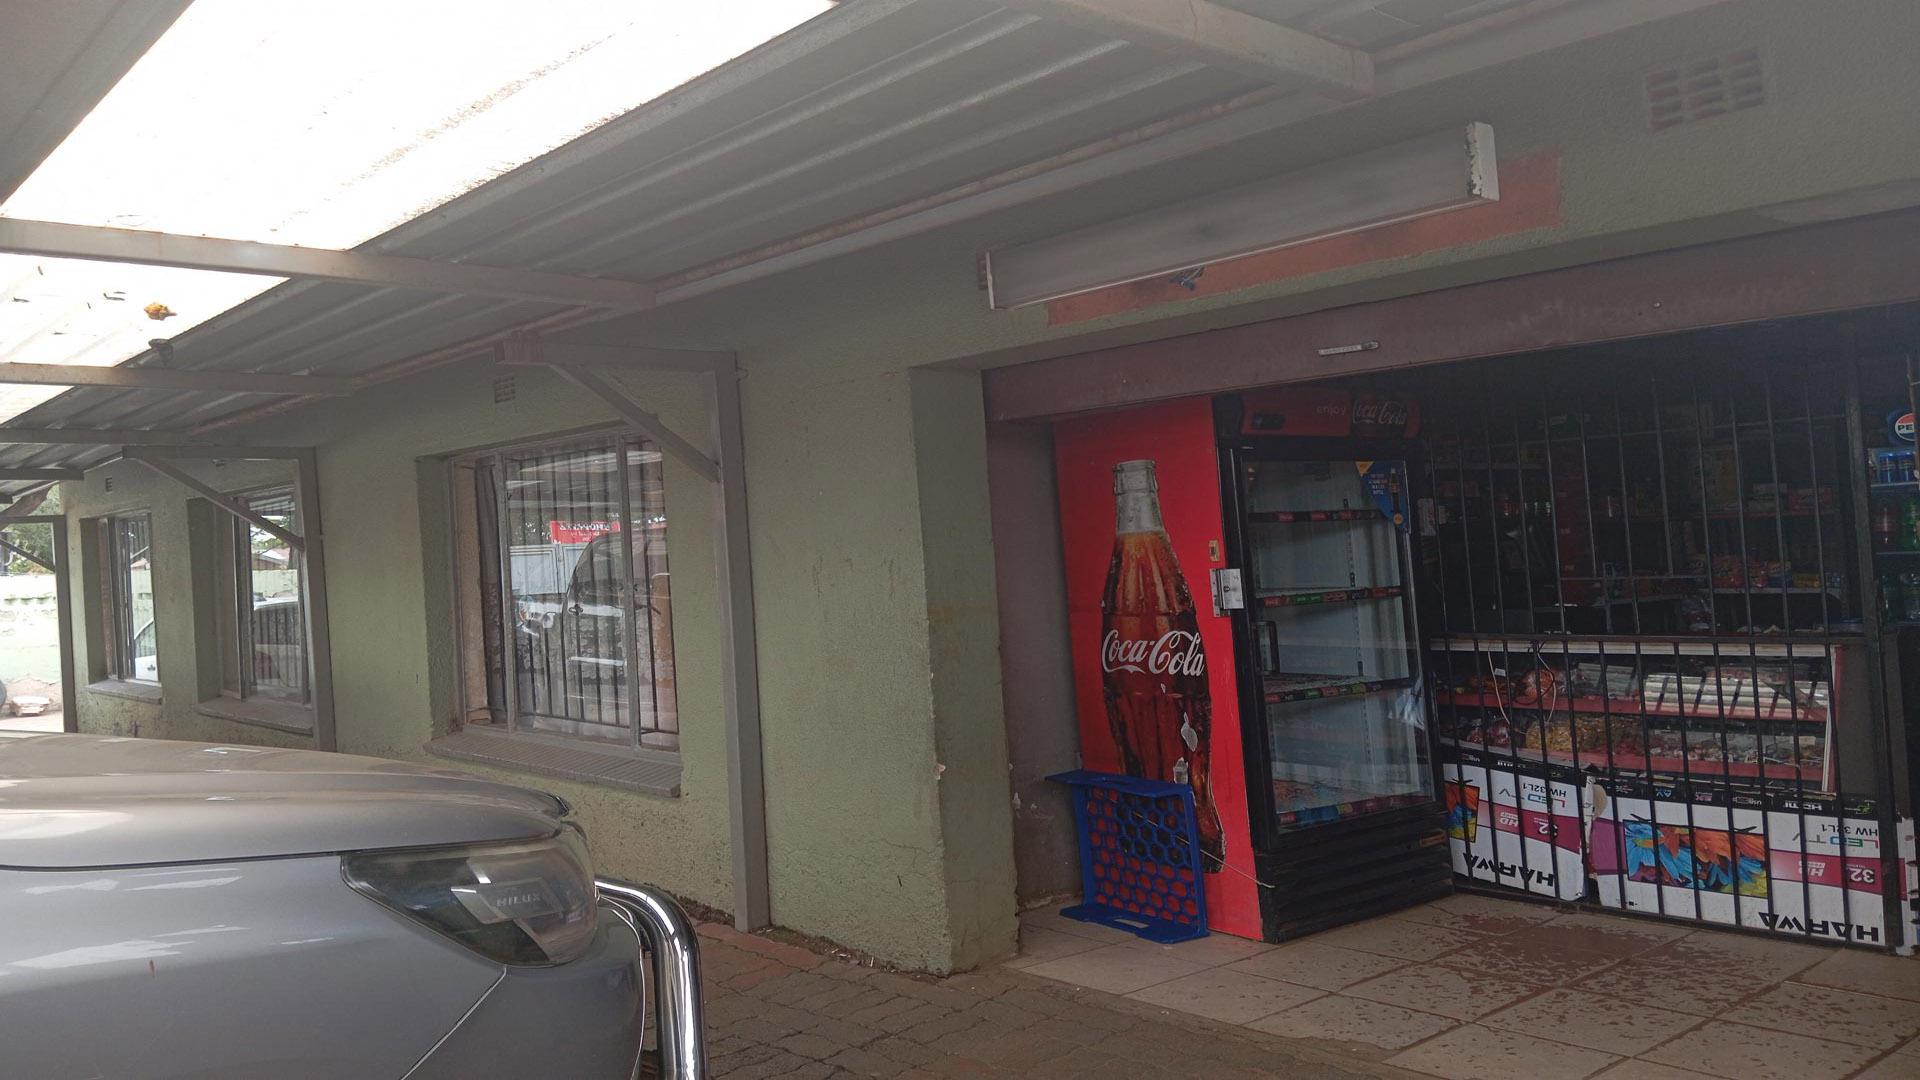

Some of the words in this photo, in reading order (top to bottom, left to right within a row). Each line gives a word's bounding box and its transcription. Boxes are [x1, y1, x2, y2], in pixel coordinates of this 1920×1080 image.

[1317, 405, 1346, 417] enjoy
[1352, 400, 1407, 425] Coca-Cola
[1102, 629, 1205, 677] Coca-Cola
[1821, 823, 1851, 833] 3L1
[1856, 827, 1878, 836] HW
[1830, 836, 1879, 849] LED
[1850, 868, 1875, 884] 32
